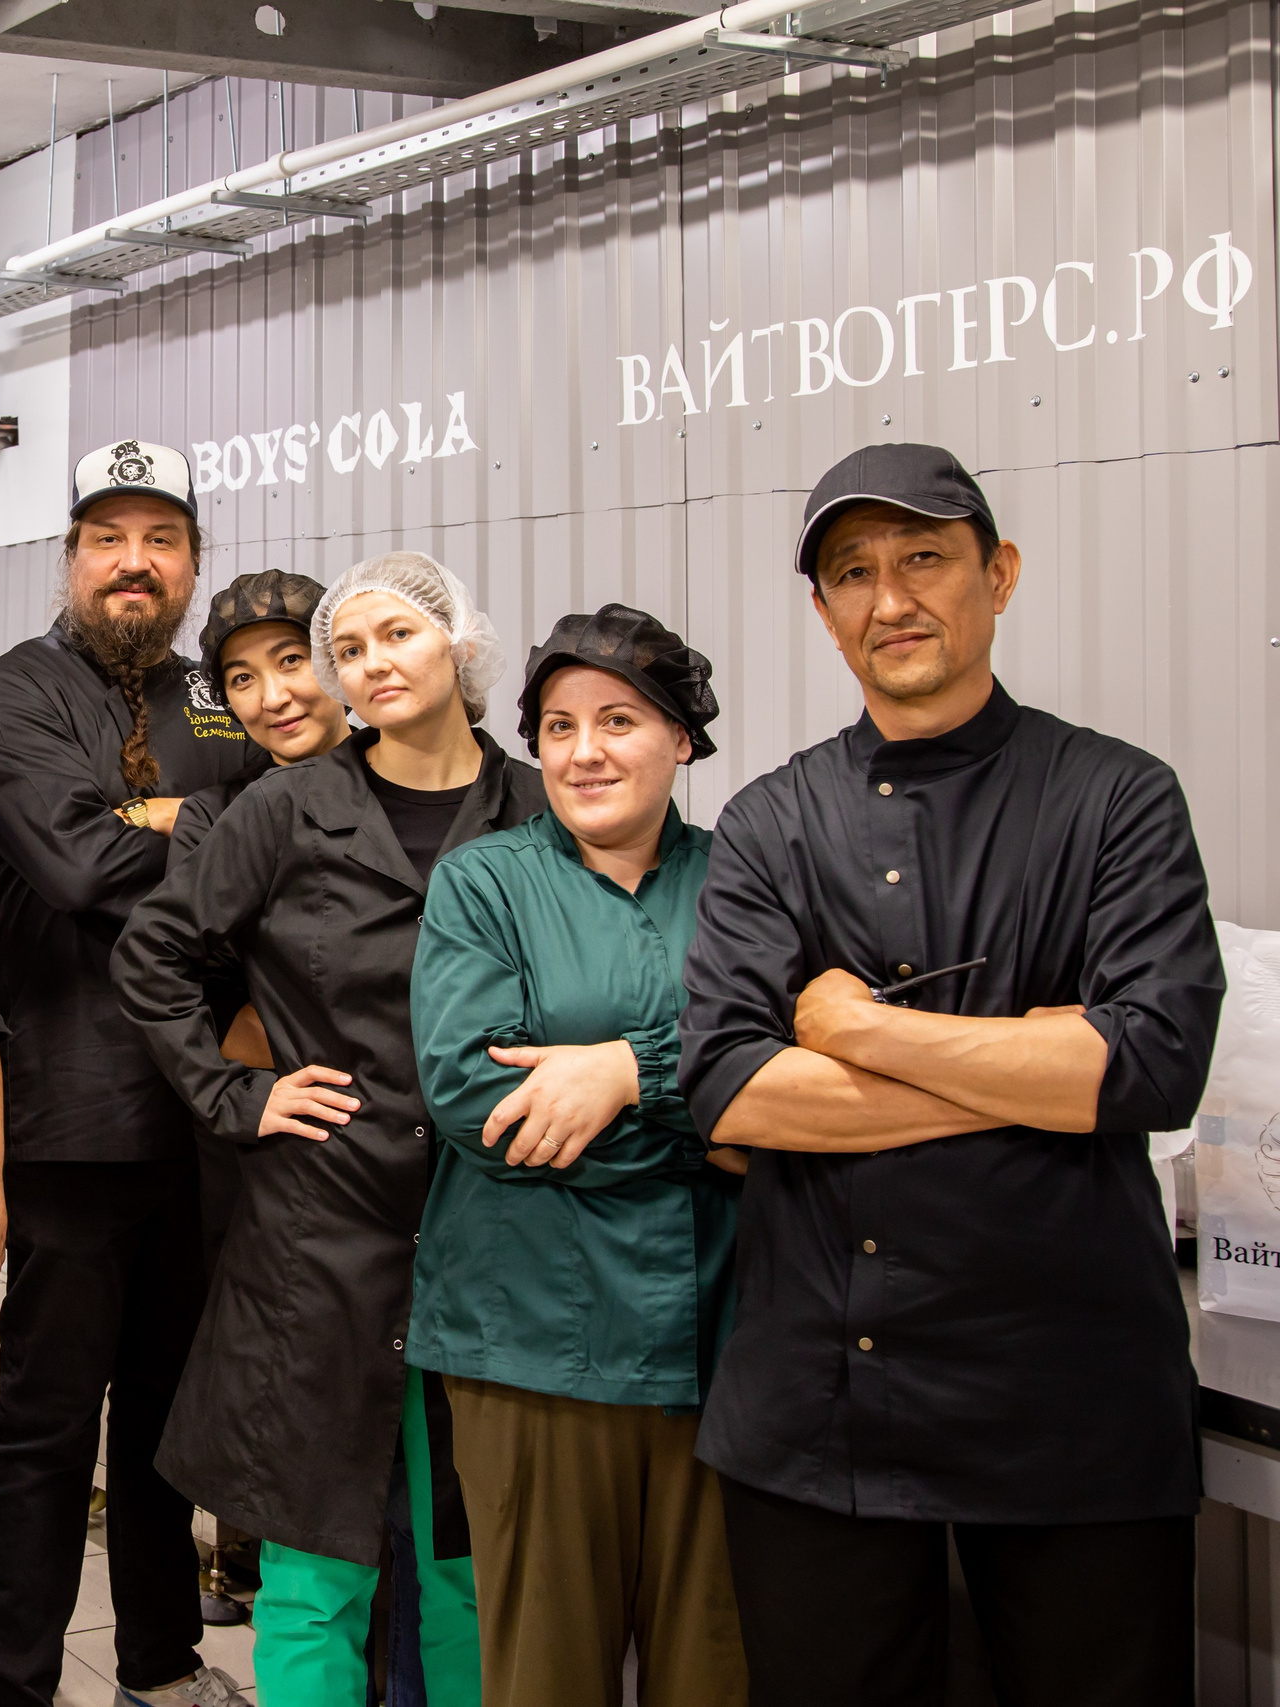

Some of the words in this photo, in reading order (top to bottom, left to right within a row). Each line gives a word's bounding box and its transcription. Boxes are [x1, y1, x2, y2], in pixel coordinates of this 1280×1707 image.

[616, 231, 1253, 427] ВАЙТВОТЕРС.РФ
[190, 420, 321, 494] BOYS'
[327, 390, 482, 475] COLA
